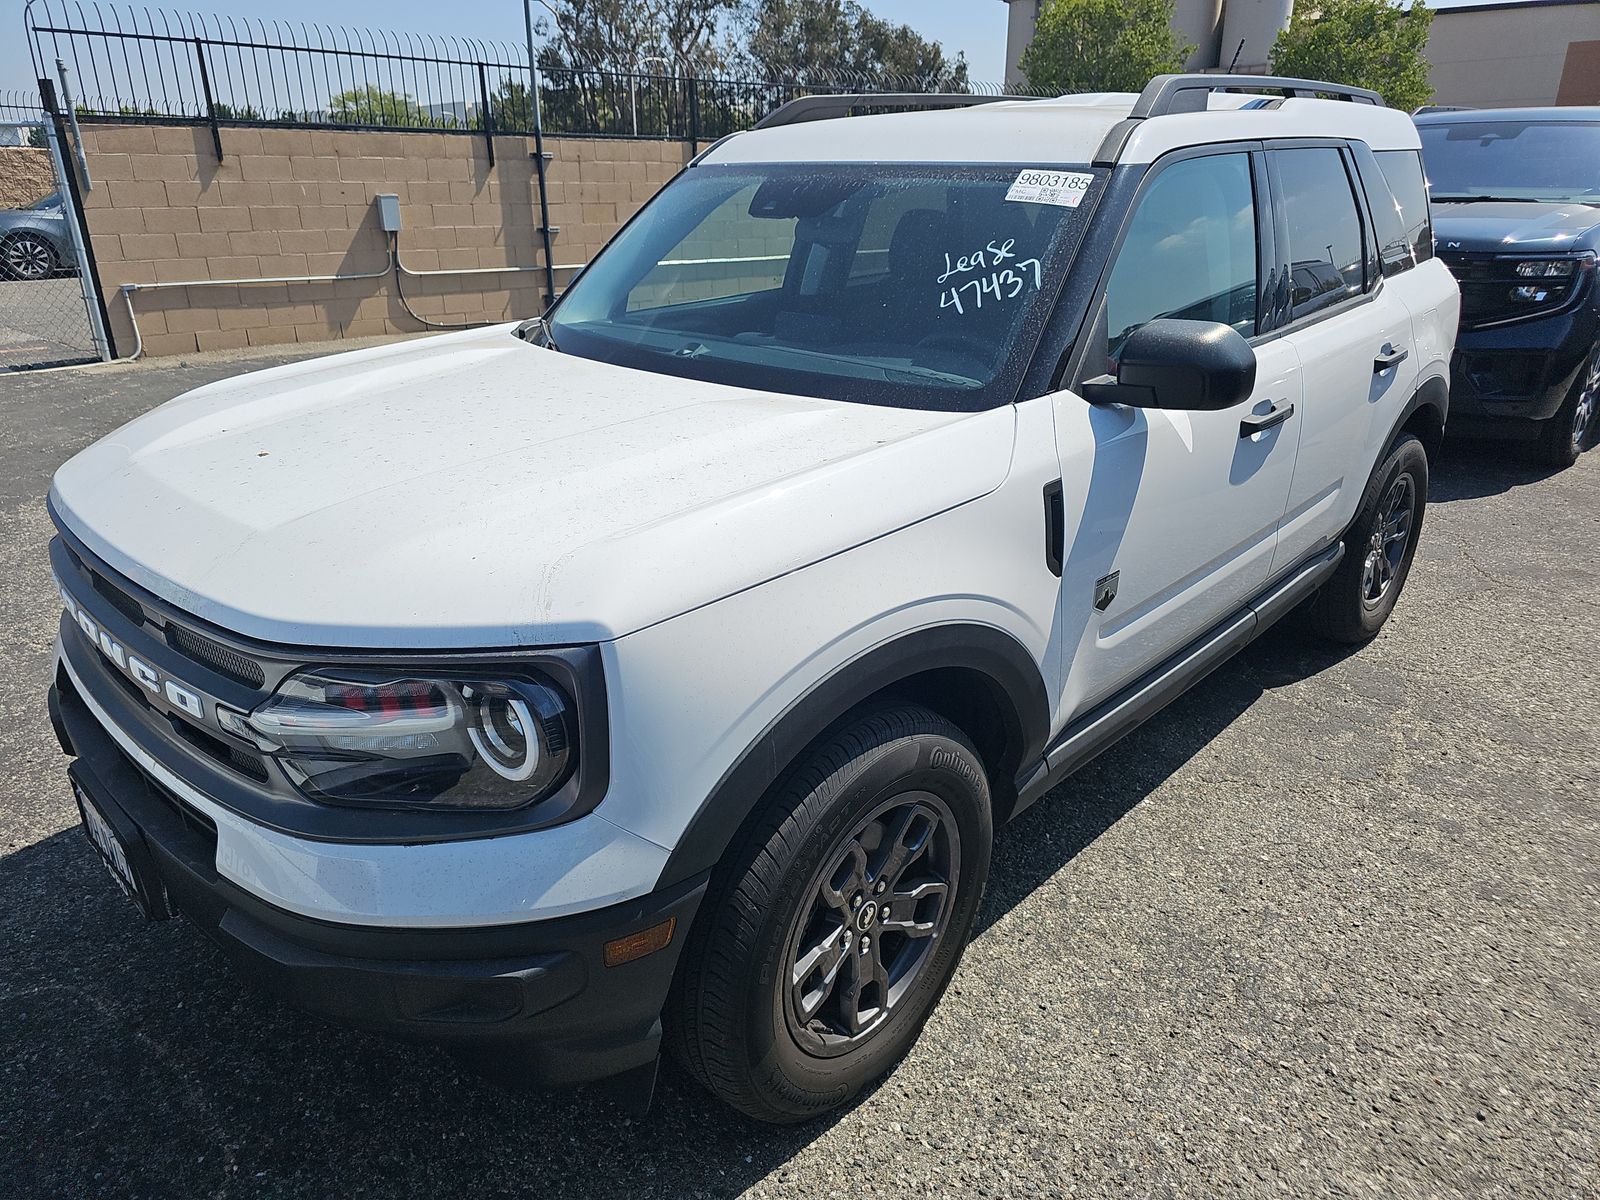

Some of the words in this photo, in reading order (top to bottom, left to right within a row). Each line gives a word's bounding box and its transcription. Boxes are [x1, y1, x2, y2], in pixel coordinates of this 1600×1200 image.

[1019, 173, 1092, 190] 9803185
[937, 239, 1015, 284] Lease
[940, 258, 1042, 314] 47437
